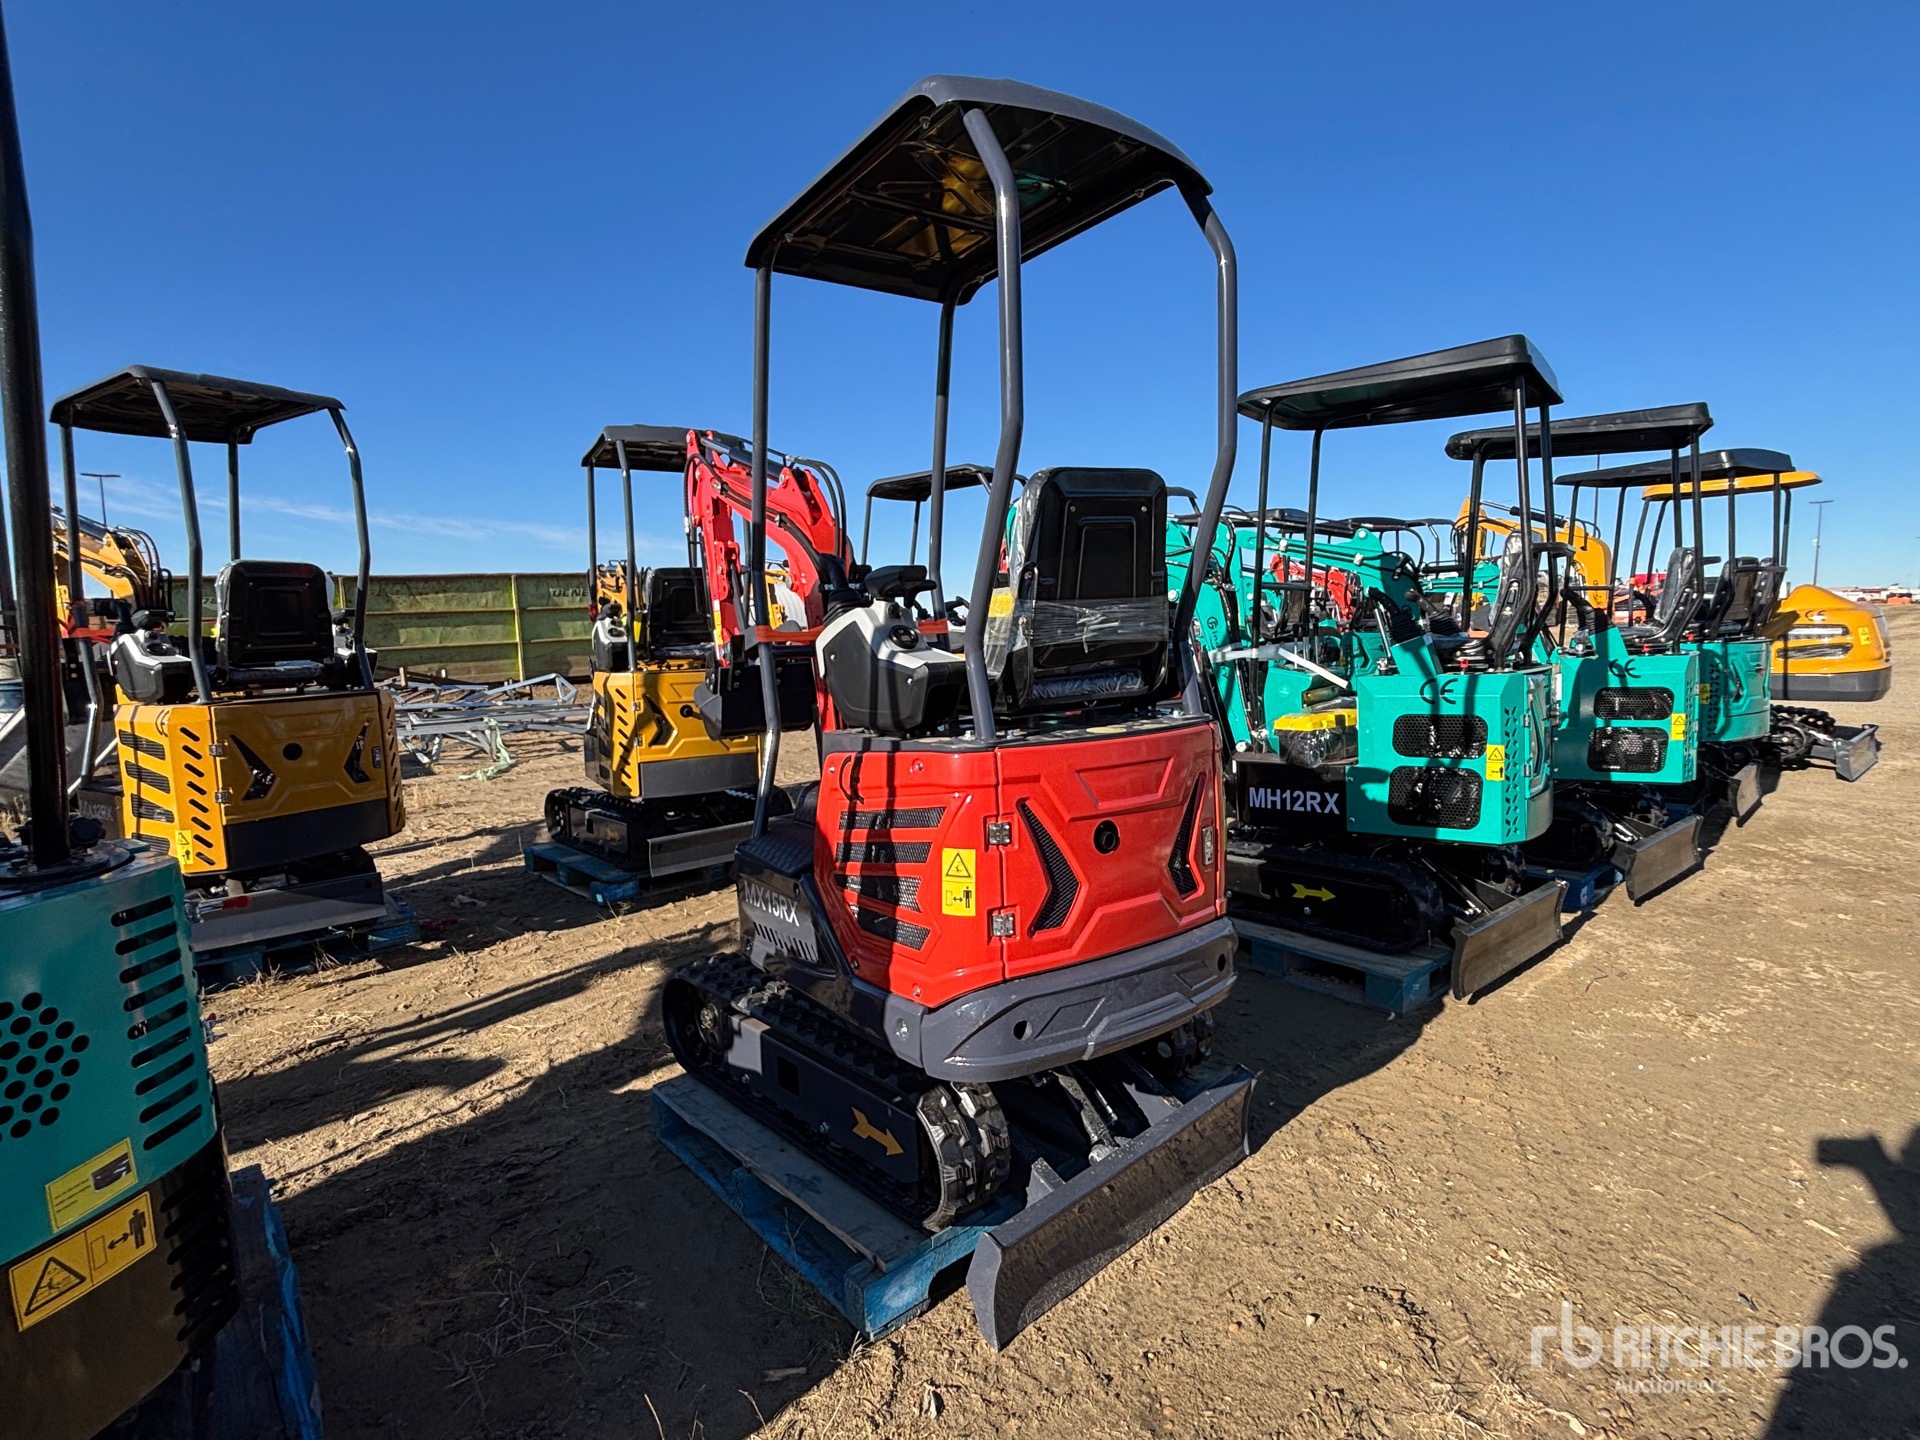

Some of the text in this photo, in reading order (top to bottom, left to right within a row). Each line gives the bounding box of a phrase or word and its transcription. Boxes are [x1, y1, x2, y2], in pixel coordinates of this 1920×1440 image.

[1608, 658, 1642, 679] CE
[1419, 677, 1459, 705] CE
[1249, 786, 1340, 815] MH12RX
[744, 879, 800, 928] MX15RX
